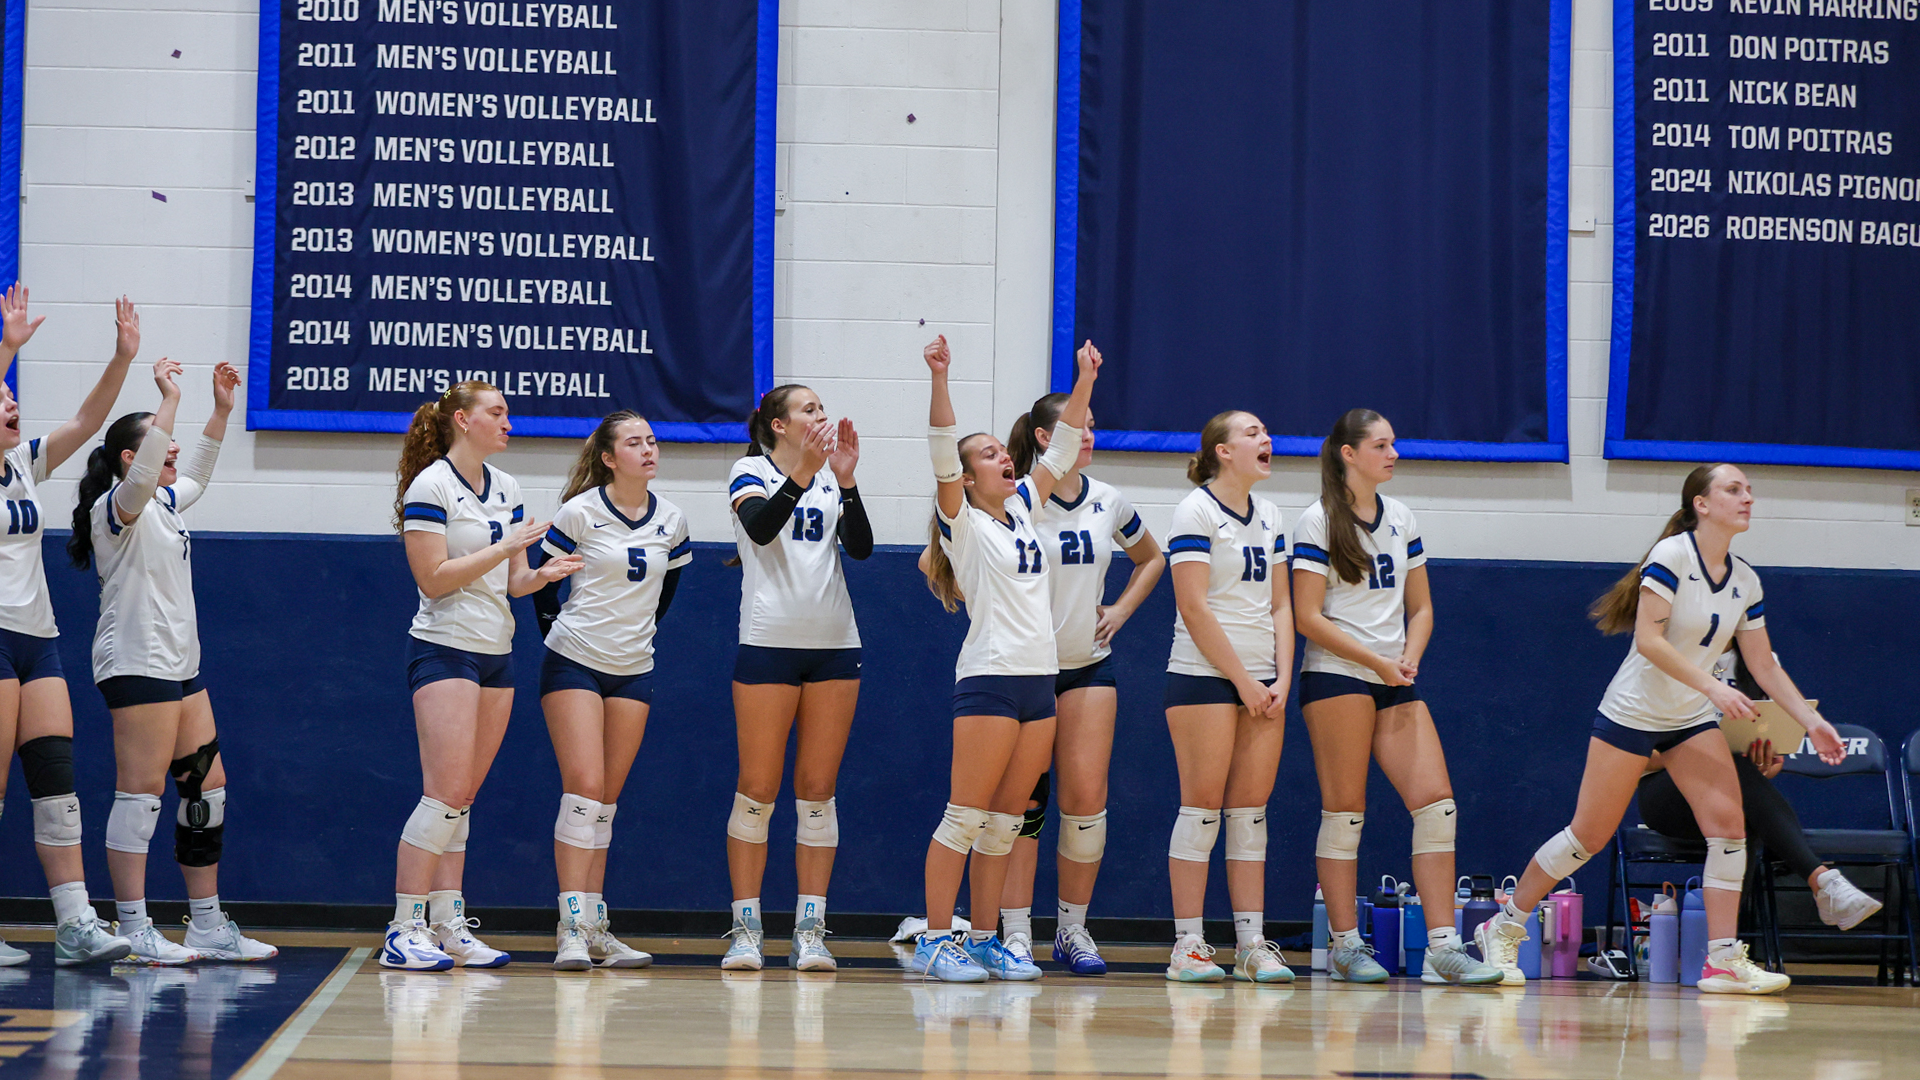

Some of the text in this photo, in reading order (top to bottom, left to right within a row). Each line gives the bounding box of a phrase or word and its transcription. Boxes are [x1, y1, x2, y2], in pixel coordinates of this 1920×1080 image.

[298, 0, 617, 29] 2010 MEN'S VOLLEYBALL
[1809, 0, 1920, 20] HARRING
[298, 43, 616, 75] 2011 MEN'S VOLLEYBALL
[1654, 33, 1889, 64] 2011 DON POITRAS
[298, 90, 656, 122] 2011 WOMEN'S VOLLEYBALL
[1654, 78, 1856, 108] 2011 NICK BEAN
[295, 136, 614, 167] 2012 MEN'S VOLLEYBALL
[1653, 123, 1892, 155] 2014 TOM POITRAS
[294, 182, 613, 213] 2013 MEN'S VOLLEYBALL
[1651, 168, 1711, 193] 2024
[1729, 170, 1831, 197] NIKOLAS
[292, 228, 654, 261] 2013 WOMEN'S VOLLEYBALL
[1649, 214, 1709, 238] 2026
[1727, 216, 1853, 243] ROBENSON
[291, 274, 611, 306] 2014 MEN'S VOLLEYBALL
[289, 320, 653, 354] 2014 WOMEN'S VOLLEYBALL
[288, 366, 350, 390] 2018
[369, 367, 450, 393] MEN'S
[6, 499, 39, 535] 10
[487, 520, 504, 545] 2
[792, 506, 824, 542] 13
[1058, 529, 1095, 566] 21
[627, 547, 648, 582] 5
[1241, 546, 1268, 583] 15
[1368, 553, 1396, 590] 12
[1699, 613, 1719, 647] 1
